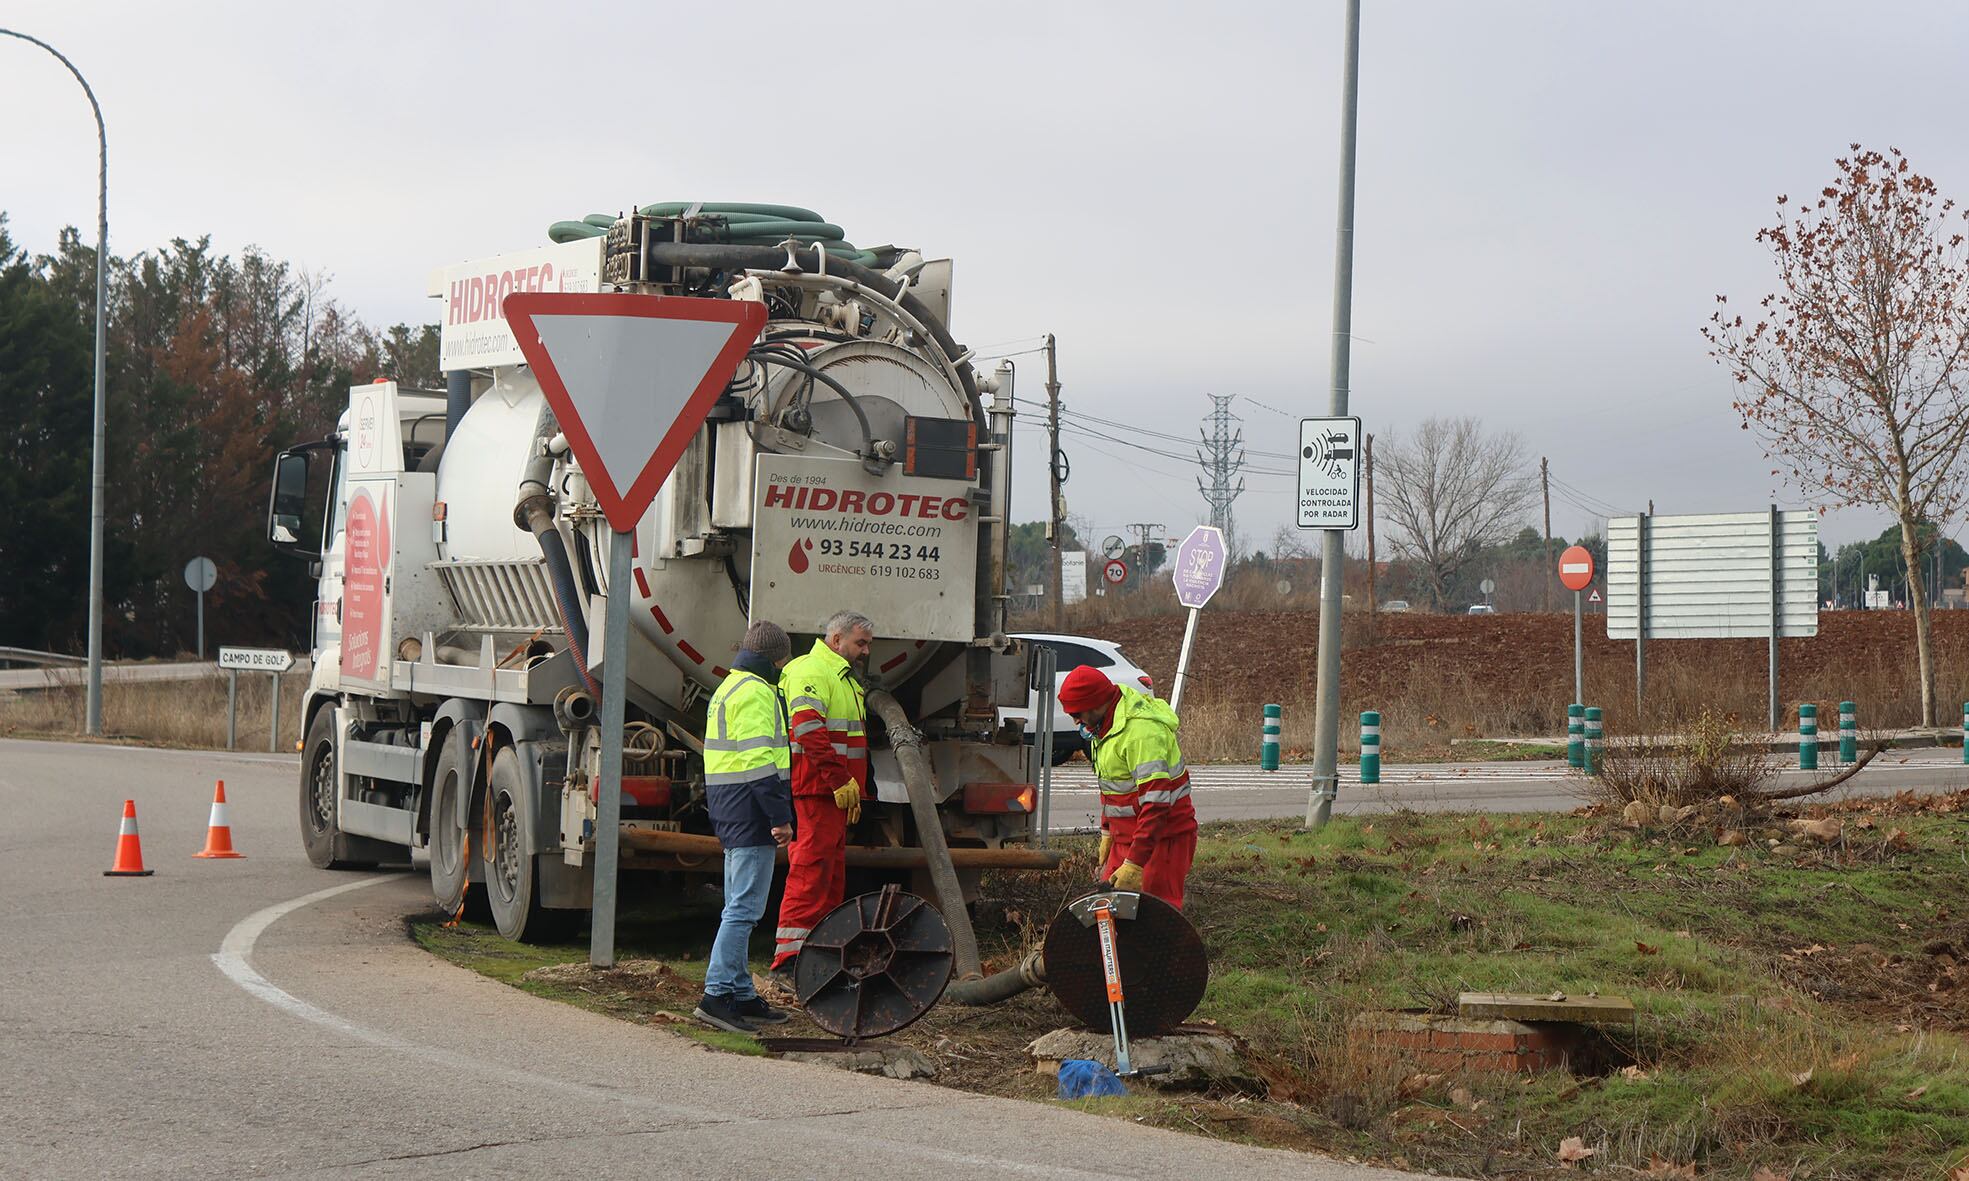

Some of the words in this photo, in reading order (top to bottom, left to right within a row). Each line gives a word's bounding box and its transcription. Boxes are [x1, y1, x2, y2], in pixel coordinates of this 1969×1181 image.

[445, 331, 508, 358] www.hidrotec.com
[769, 473, 788, 483] Des
[790, 474, 802, 484] de
[805, 476, 827, 486] 1994
[1305, 488, 1348, 496] VELOCIDAD
[764, 485, 970, 521] HIDROTEC
[1300, 499, 1352, 507] CONTROLADA
[1304, 510, 1319, 518] POR
[1322, 510, 1348, 518] RADAR
[790, 516, 942, 538] www.hidrotec.com
[820, 538, 843, 556] 93
[848, 541, 884, 559] 544
[888, 543, 912, 560] 23
[916, 545, 940, 562] 44
[818, 563, 866, 575] URGÈNCIES
[870, 565, 892, 577] 619
[895, 566, 916, 579] 102
[918, 568, 940, 580] 683
[1108, 568, 1122, 577] 70
[222, 652, 250, 664] CAMPO
[253, 654, 263, 664] DE
[265, 655, 285, 666] GOLF
